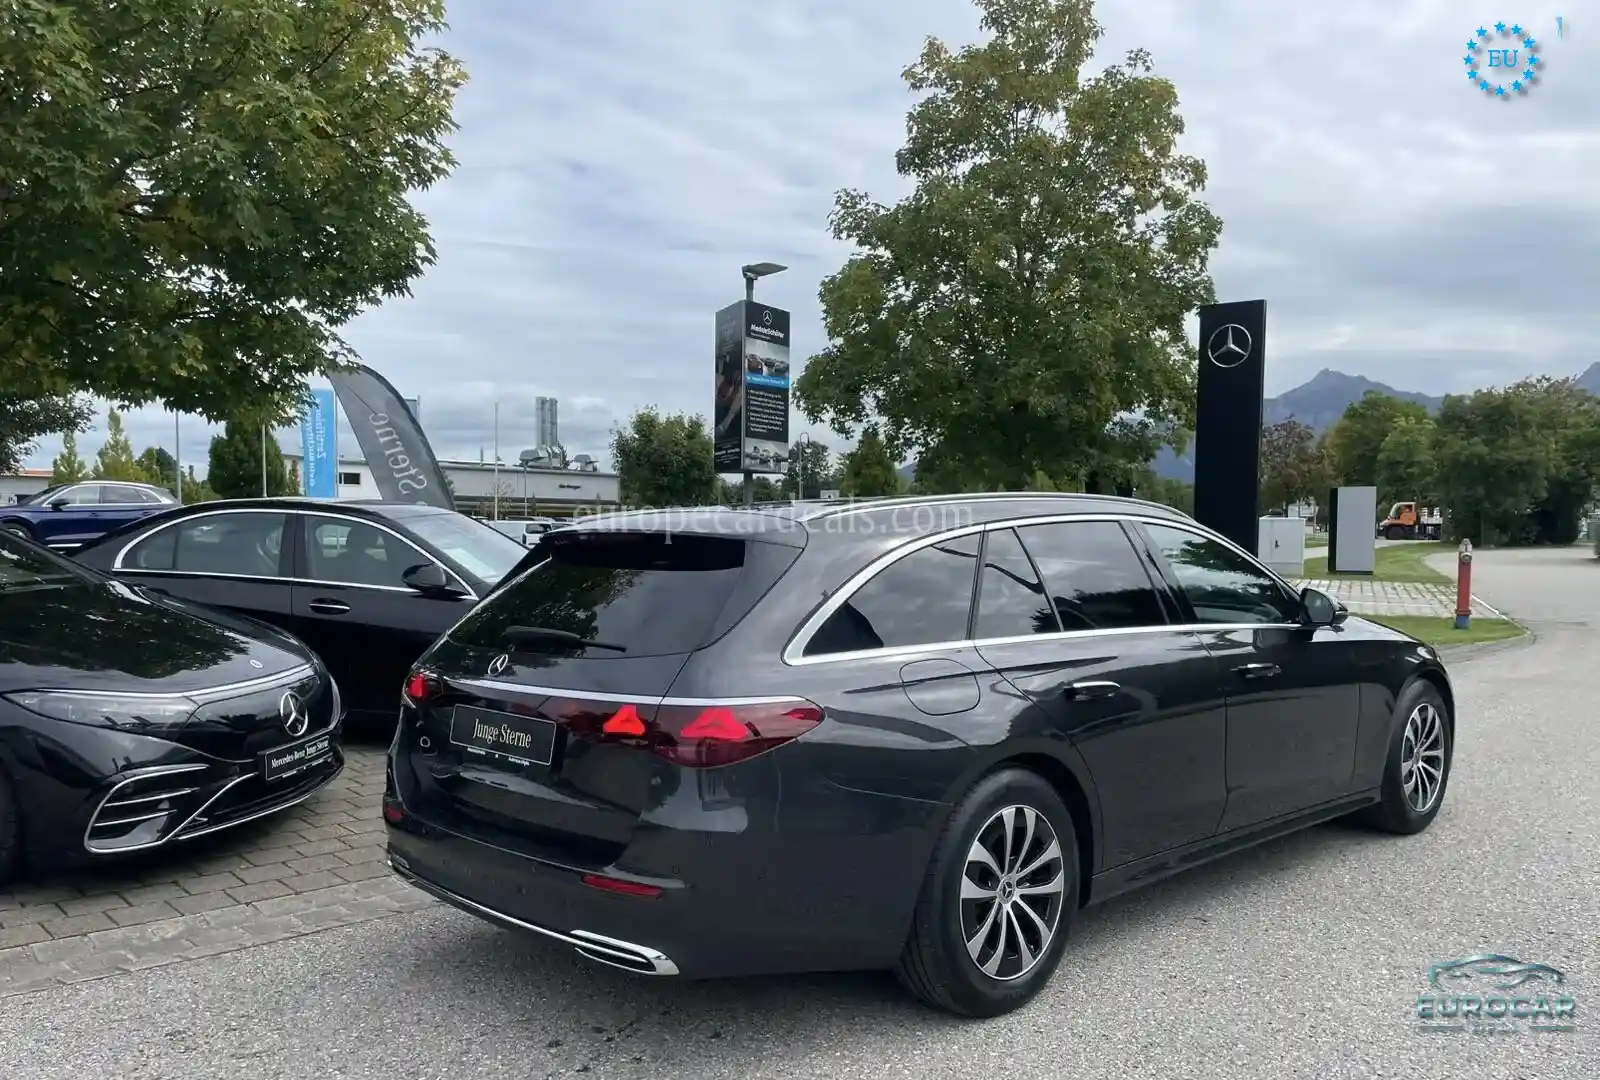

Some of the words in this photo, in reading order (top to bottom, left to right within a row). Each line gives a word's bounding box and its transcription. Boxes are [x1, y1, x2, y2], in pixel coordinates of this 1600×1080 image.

[472, 718, 499, 744] Junge
[499, 723, 532, 749] Sterne
[271, 749, 306, 769] Mercedes-Benz
